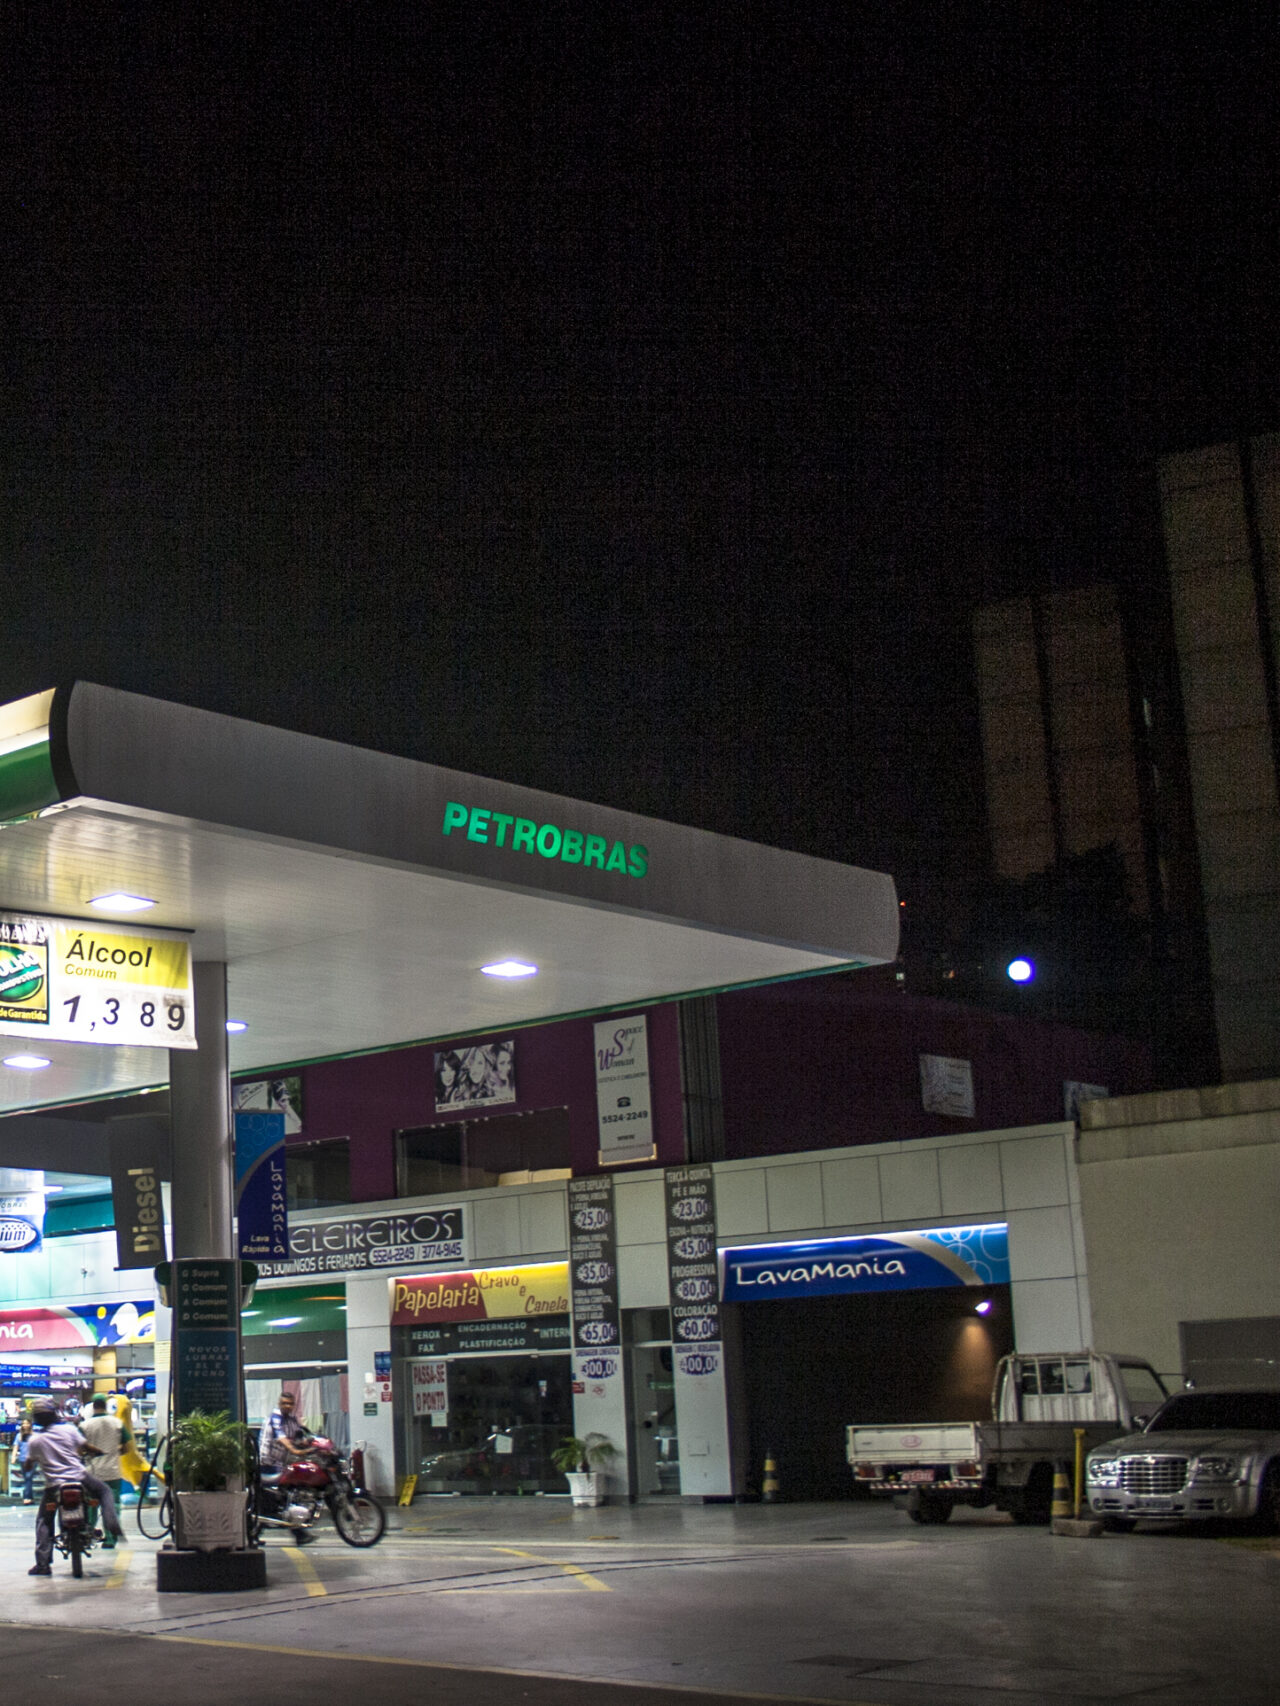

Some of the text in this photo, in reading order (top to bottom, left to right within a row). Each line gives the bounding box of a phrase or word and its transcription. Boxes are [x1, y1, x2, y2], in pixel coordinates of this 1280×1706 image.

[442, 801, 648, 878] PETROBRAS
[66, 934, 152, 968] Álcool
[65, 963, 117, 980] Comum
[8, 1009, 47, 1021] Garantida
[602, 1110, 648, 1124] 5524-2249
[128, 1168, 160, 1252] Diesel
[319, 1256, 324, 1270] E
[326, 1253, 366, 1269] FERIADOS
[192, 1269, 219, 1278] Supra
[672, 1263, 716, 1278] PROGRESSIVA
[736, 1257, 905, 1286] LavaMania
[479, 1272, 519, 1290] Cravo
[519, 1285, 526, 1297] e
[395, 1283, 480, 1316] Papelaria
[525, 1295, 568, 1314] Canela
[192, 1312, 228, 1320] Comum
[674, 1302, 718, 1318] COLORAÇÃO
[411, 1331, 440, 1339] XEROX
[458, 1321, 527, 1333] ENCADERNAÇÃO
[418, 1344, 435, 1352] FAX
[459, 1338, 526, 1349] PLASTIFICAÇÃO
[414, 1364, 445, 1385] PASSA-SE
